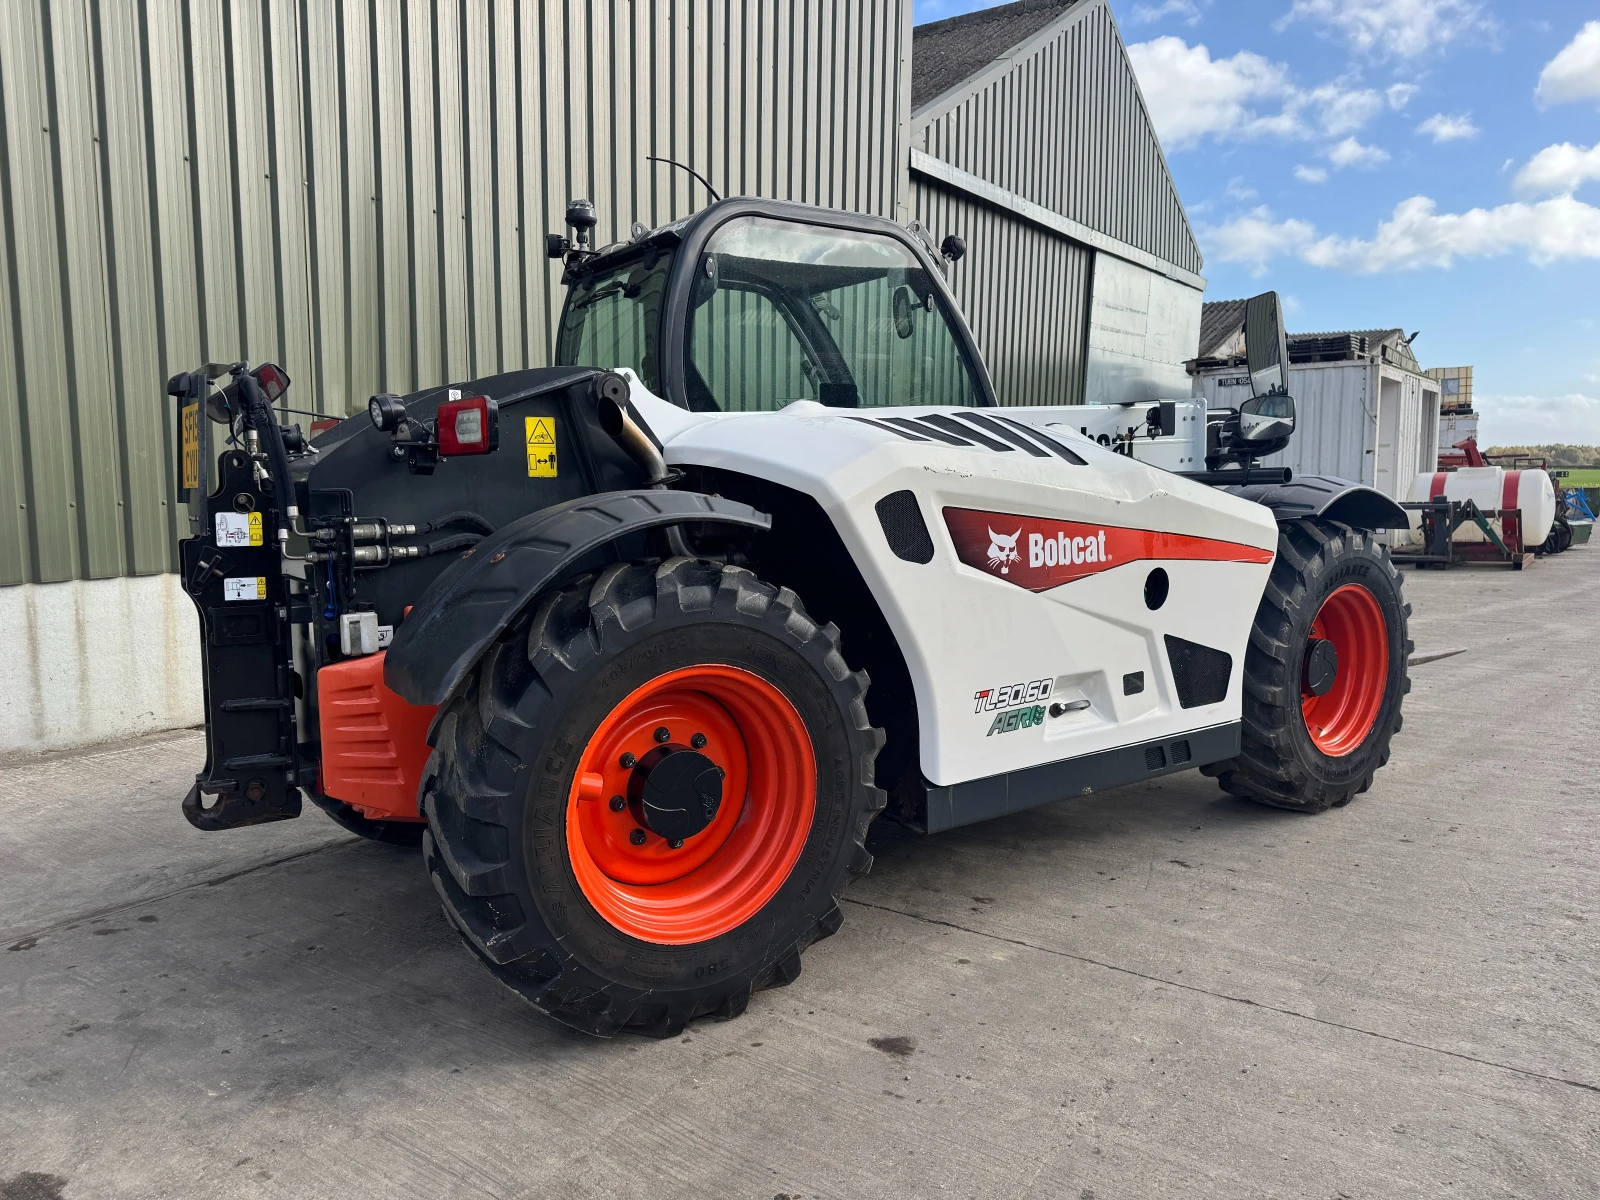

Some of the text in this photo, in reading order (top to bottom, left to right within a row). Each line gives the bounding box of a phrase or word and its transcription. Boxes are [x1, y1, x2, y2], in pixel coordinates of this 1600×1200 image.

[1221, 378, 1237, 386] TURN
[184, 409, 198, 445] SF19
[185, 449, 198, 483] CYU
[1028, 530, 1107, 568] Bobcat
[1323, 565, 1370, 596] ALLIANCE
[974, 677, 1053, 714] TL30.60
[986, 705, 1038, 737] AGRI
[533, 736, 574, 893] ALLIANCE
[792, 755, 845, 907] AGRO INDUSTRIAL
